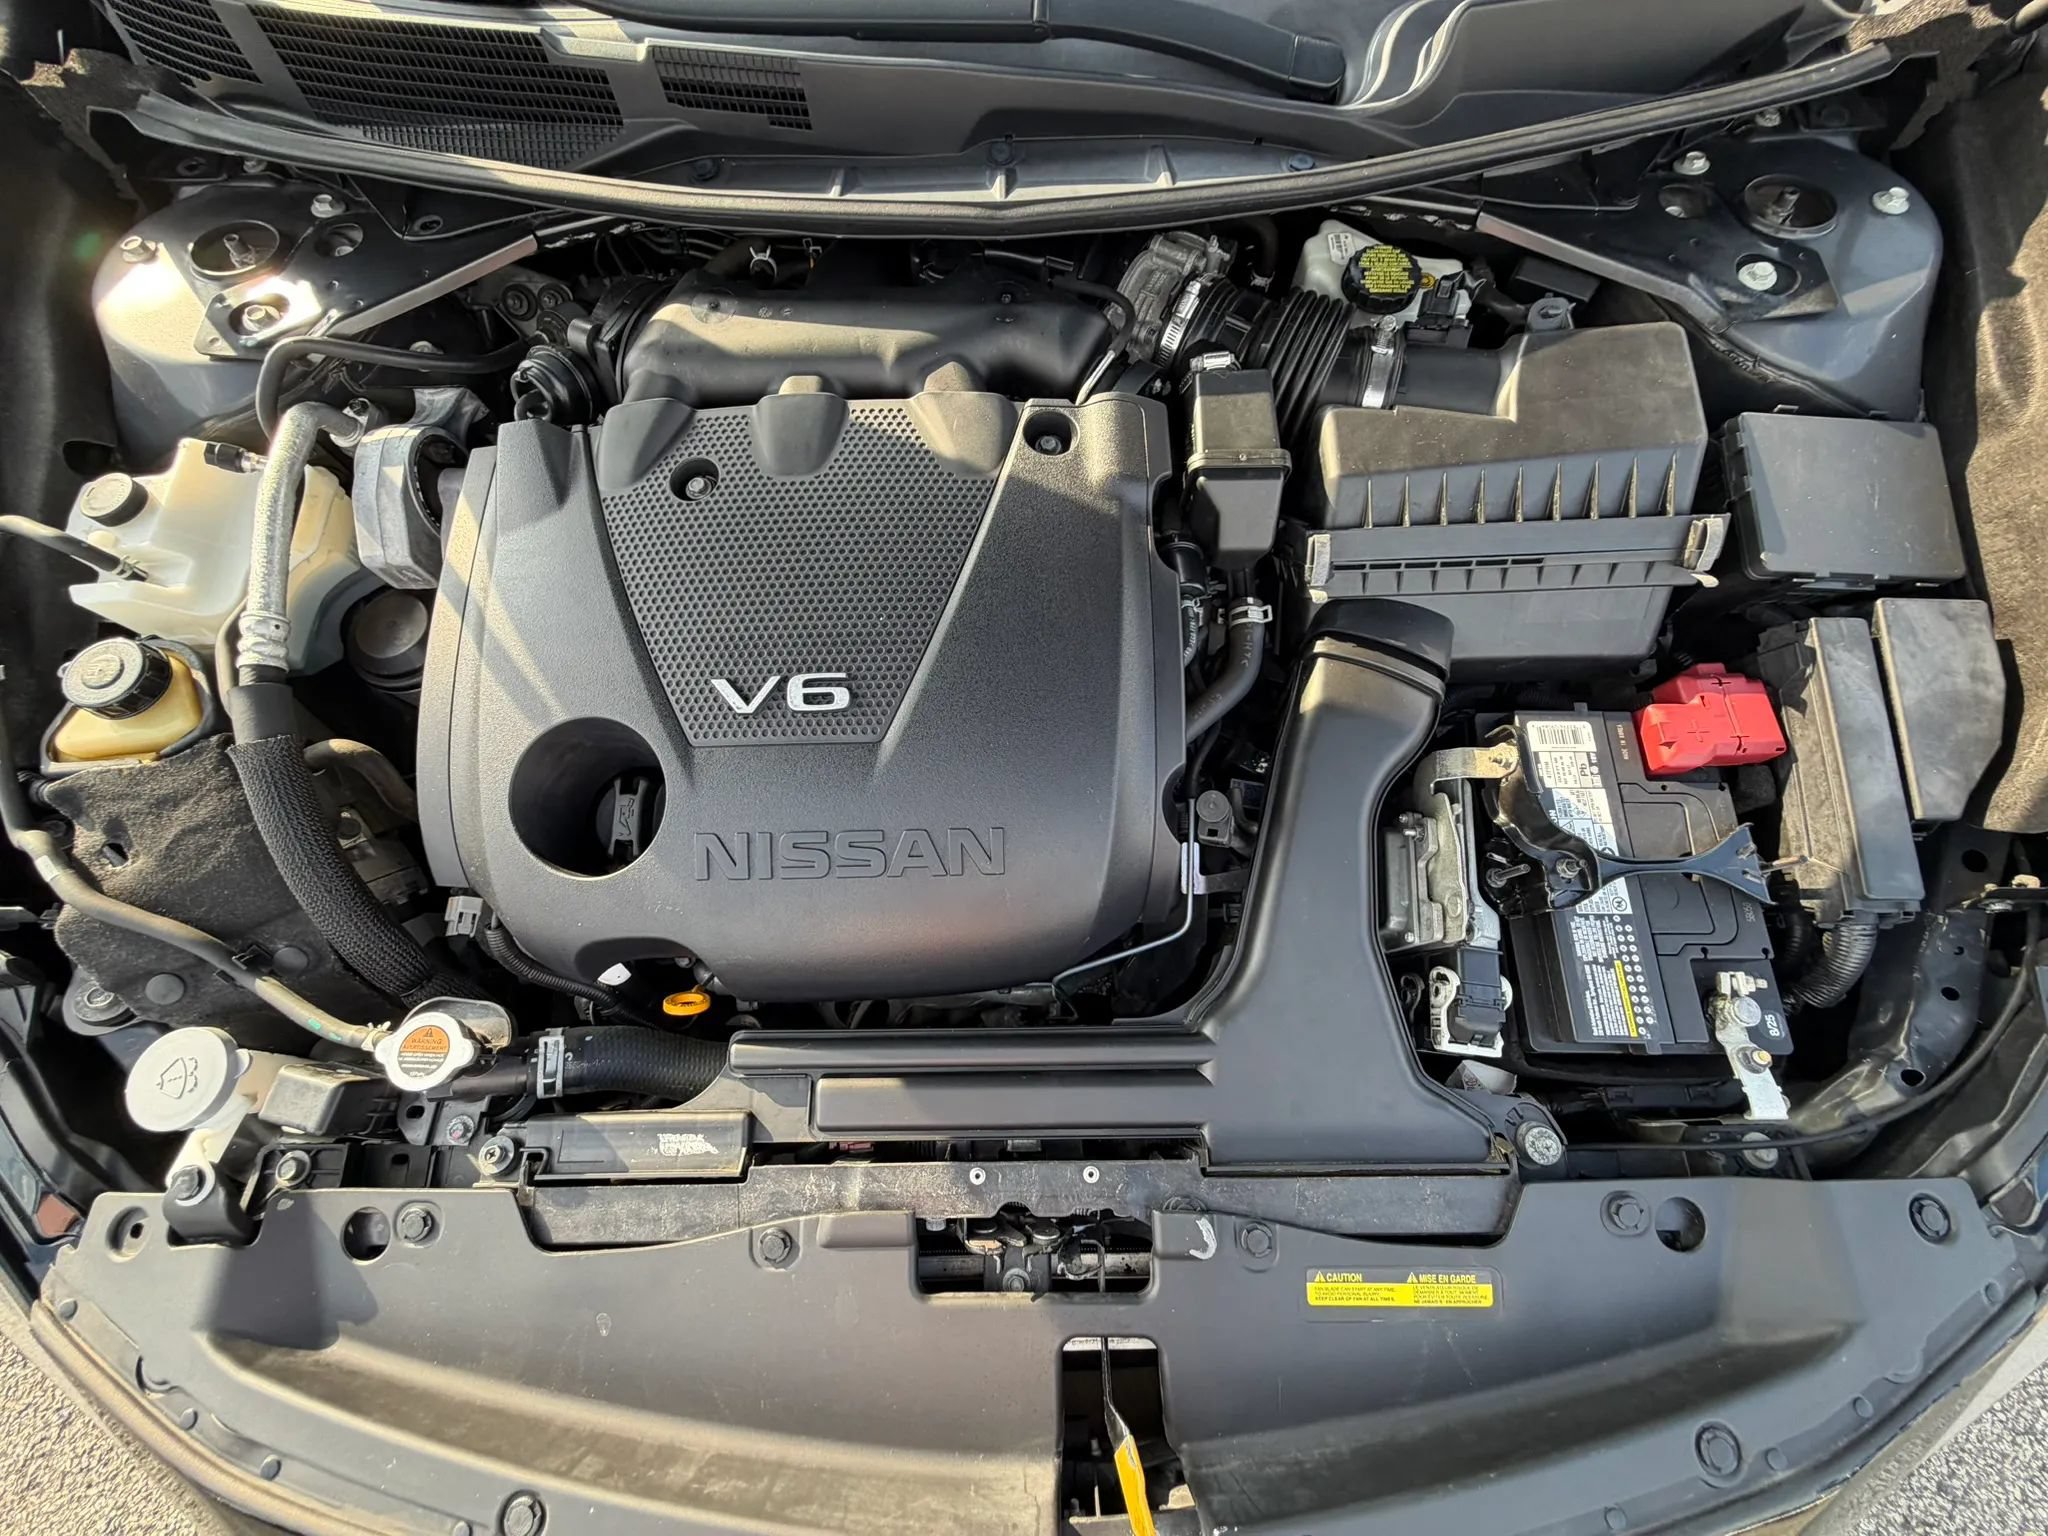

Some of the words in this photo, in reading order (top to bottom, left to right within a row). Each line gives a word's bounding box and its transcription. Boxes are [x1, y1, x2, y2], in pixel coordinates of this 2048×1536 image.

[710, 672, 850, 714] V6
[1580, 763, 1589, 776] Pb
[693, 827, 1005, 881] NISSAN
[1768, 1014, 1780, 1037] 8/25
[1326, 1273, 1362, 1282] CAUTION
[1419, 1274, 1436, 1283] MISE
[1438, 1274, 1448, 1283] EN
[1450, 1274, 1476, 1283] GARDE
